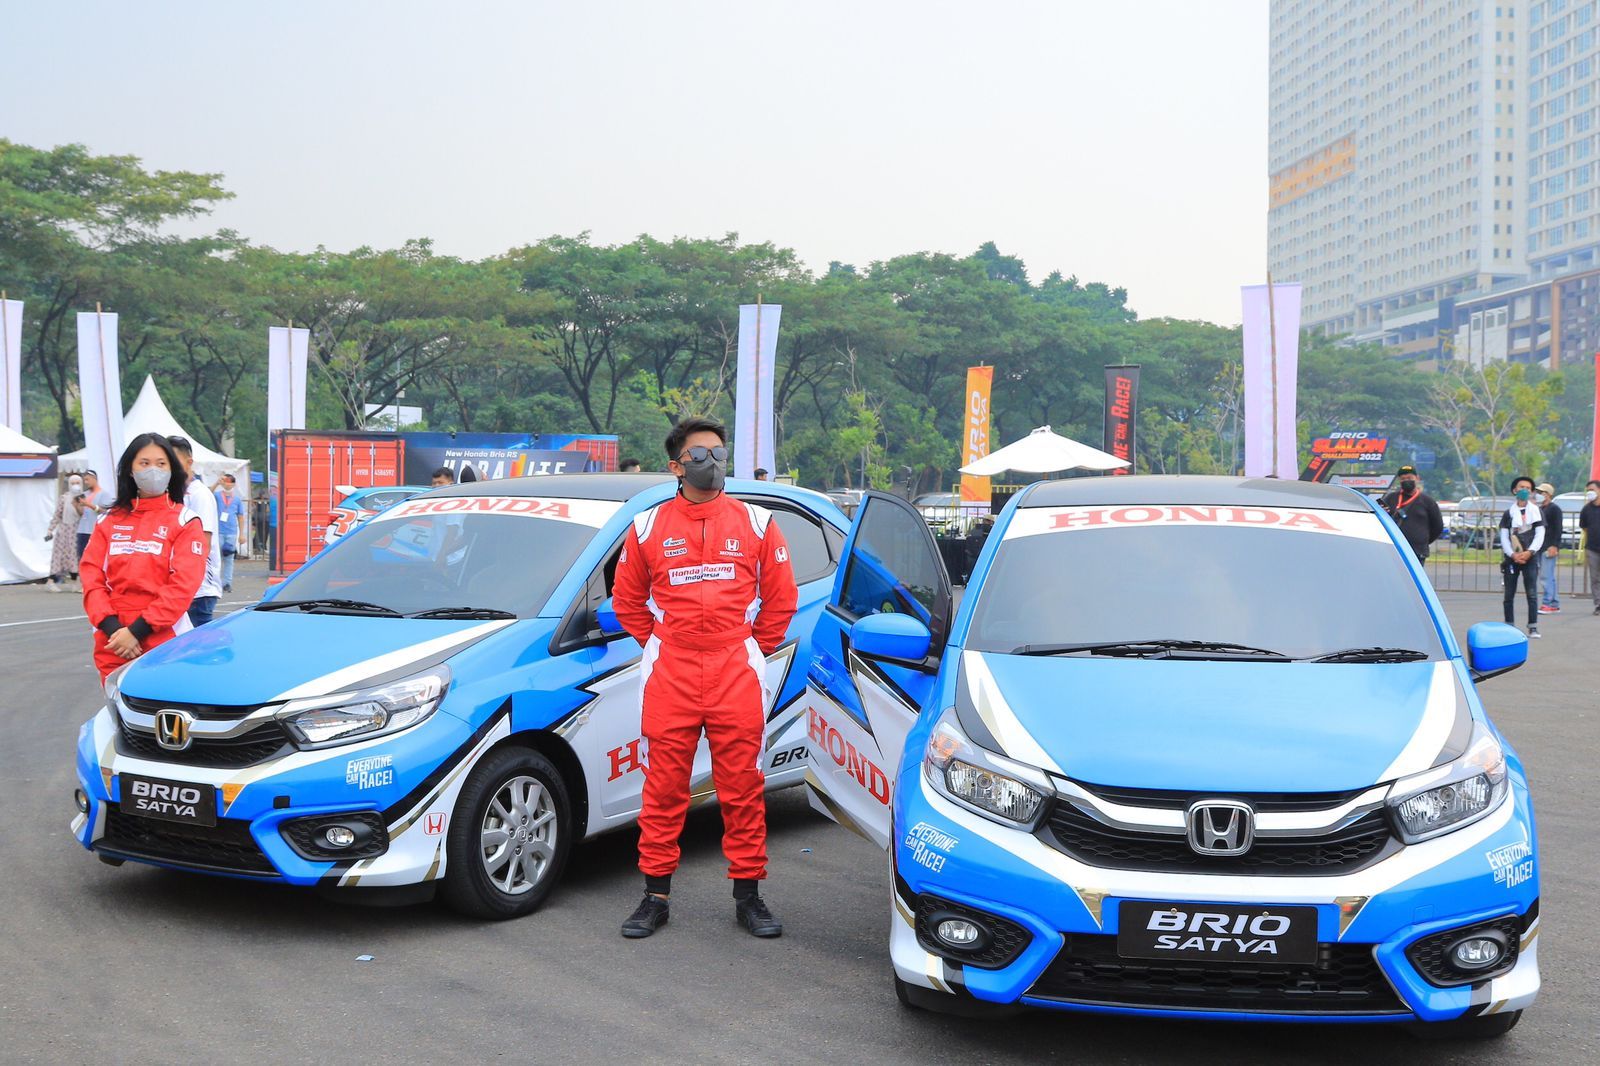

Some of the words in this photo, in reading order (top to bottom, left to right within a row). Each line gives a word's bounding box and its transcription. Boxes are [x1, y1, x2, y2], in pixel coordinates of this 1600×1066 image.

[1111, 377, 1132, 418] RACE!
[976, 398, 987, 458] ATYA
[463, 450, 488, 458] Honda
[1312, 438, 1388, 453] SLALOM
[1359, 453, 1382, 461] 2022
[394, 498, 572, 519] HONDA
[1048, 507, 1342, 532] HONDA
[671, 568, 700, 578] Honda
[703, 565, 733, 574] Racing
[346, 755, 393, 775] EVERYONE
[770, 745, 809, 769] BRI
[808, 706, 895, 810] HOND
[345, 773, 359, 784] CAN
[359, 769, 393, 790] RACE!
[131, 780, 201, 804] BRIO
[136, 798, 197, 818] SATYA
[908, 821, 959, 853] EVERYONE
[905, 835, 918, 849] CAN
[912, 840, 947, 873] RACE!
[1493, 867, 1506, 882] CAN
[1506, 859, 1534, 889] RACE!
[1146, 910, 1291, 937] BRIO
[1153, 934, 1278, 955] SATYA
